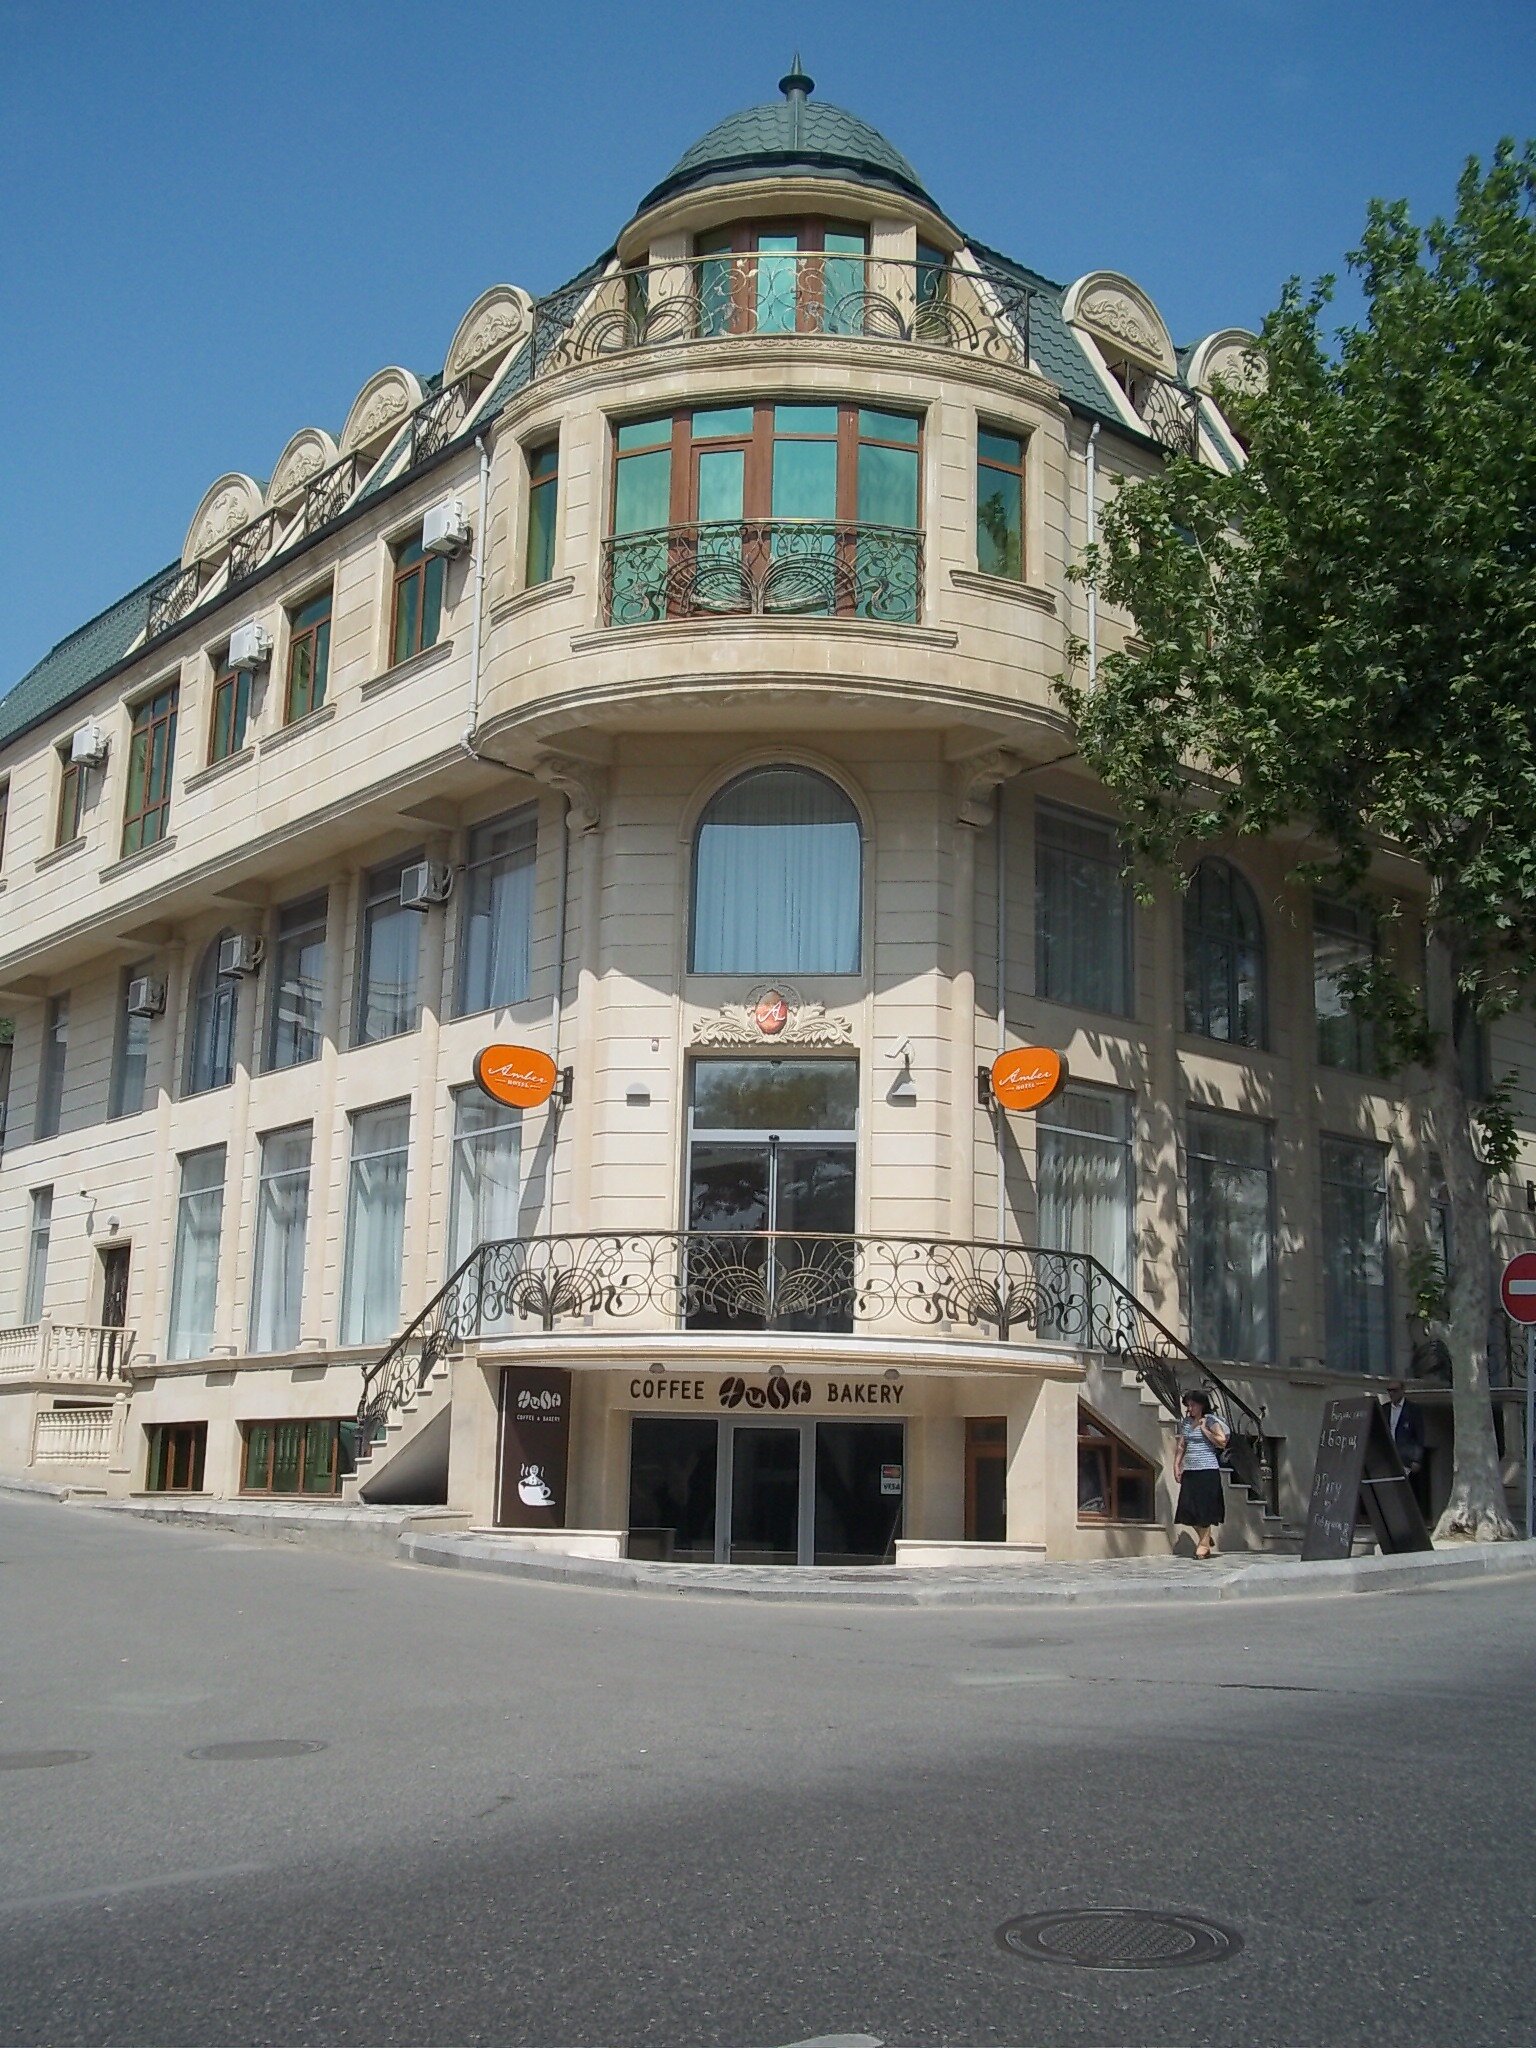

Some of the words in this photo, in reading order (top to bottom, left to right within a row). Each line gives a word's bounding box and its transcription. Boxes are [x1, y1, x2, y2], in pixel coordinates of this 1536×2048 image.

[488, 1063, 548, 1084] Amber
[998, 1067, 1052, 1086] Amber
[507, 1080, 530, 1089] HOTEL
[1015, 1083, 1036, 1092] HOTEL
[630, 1379, 705, 1400] COFFEE
[827, 1383, 904, 1404] BAKERY
